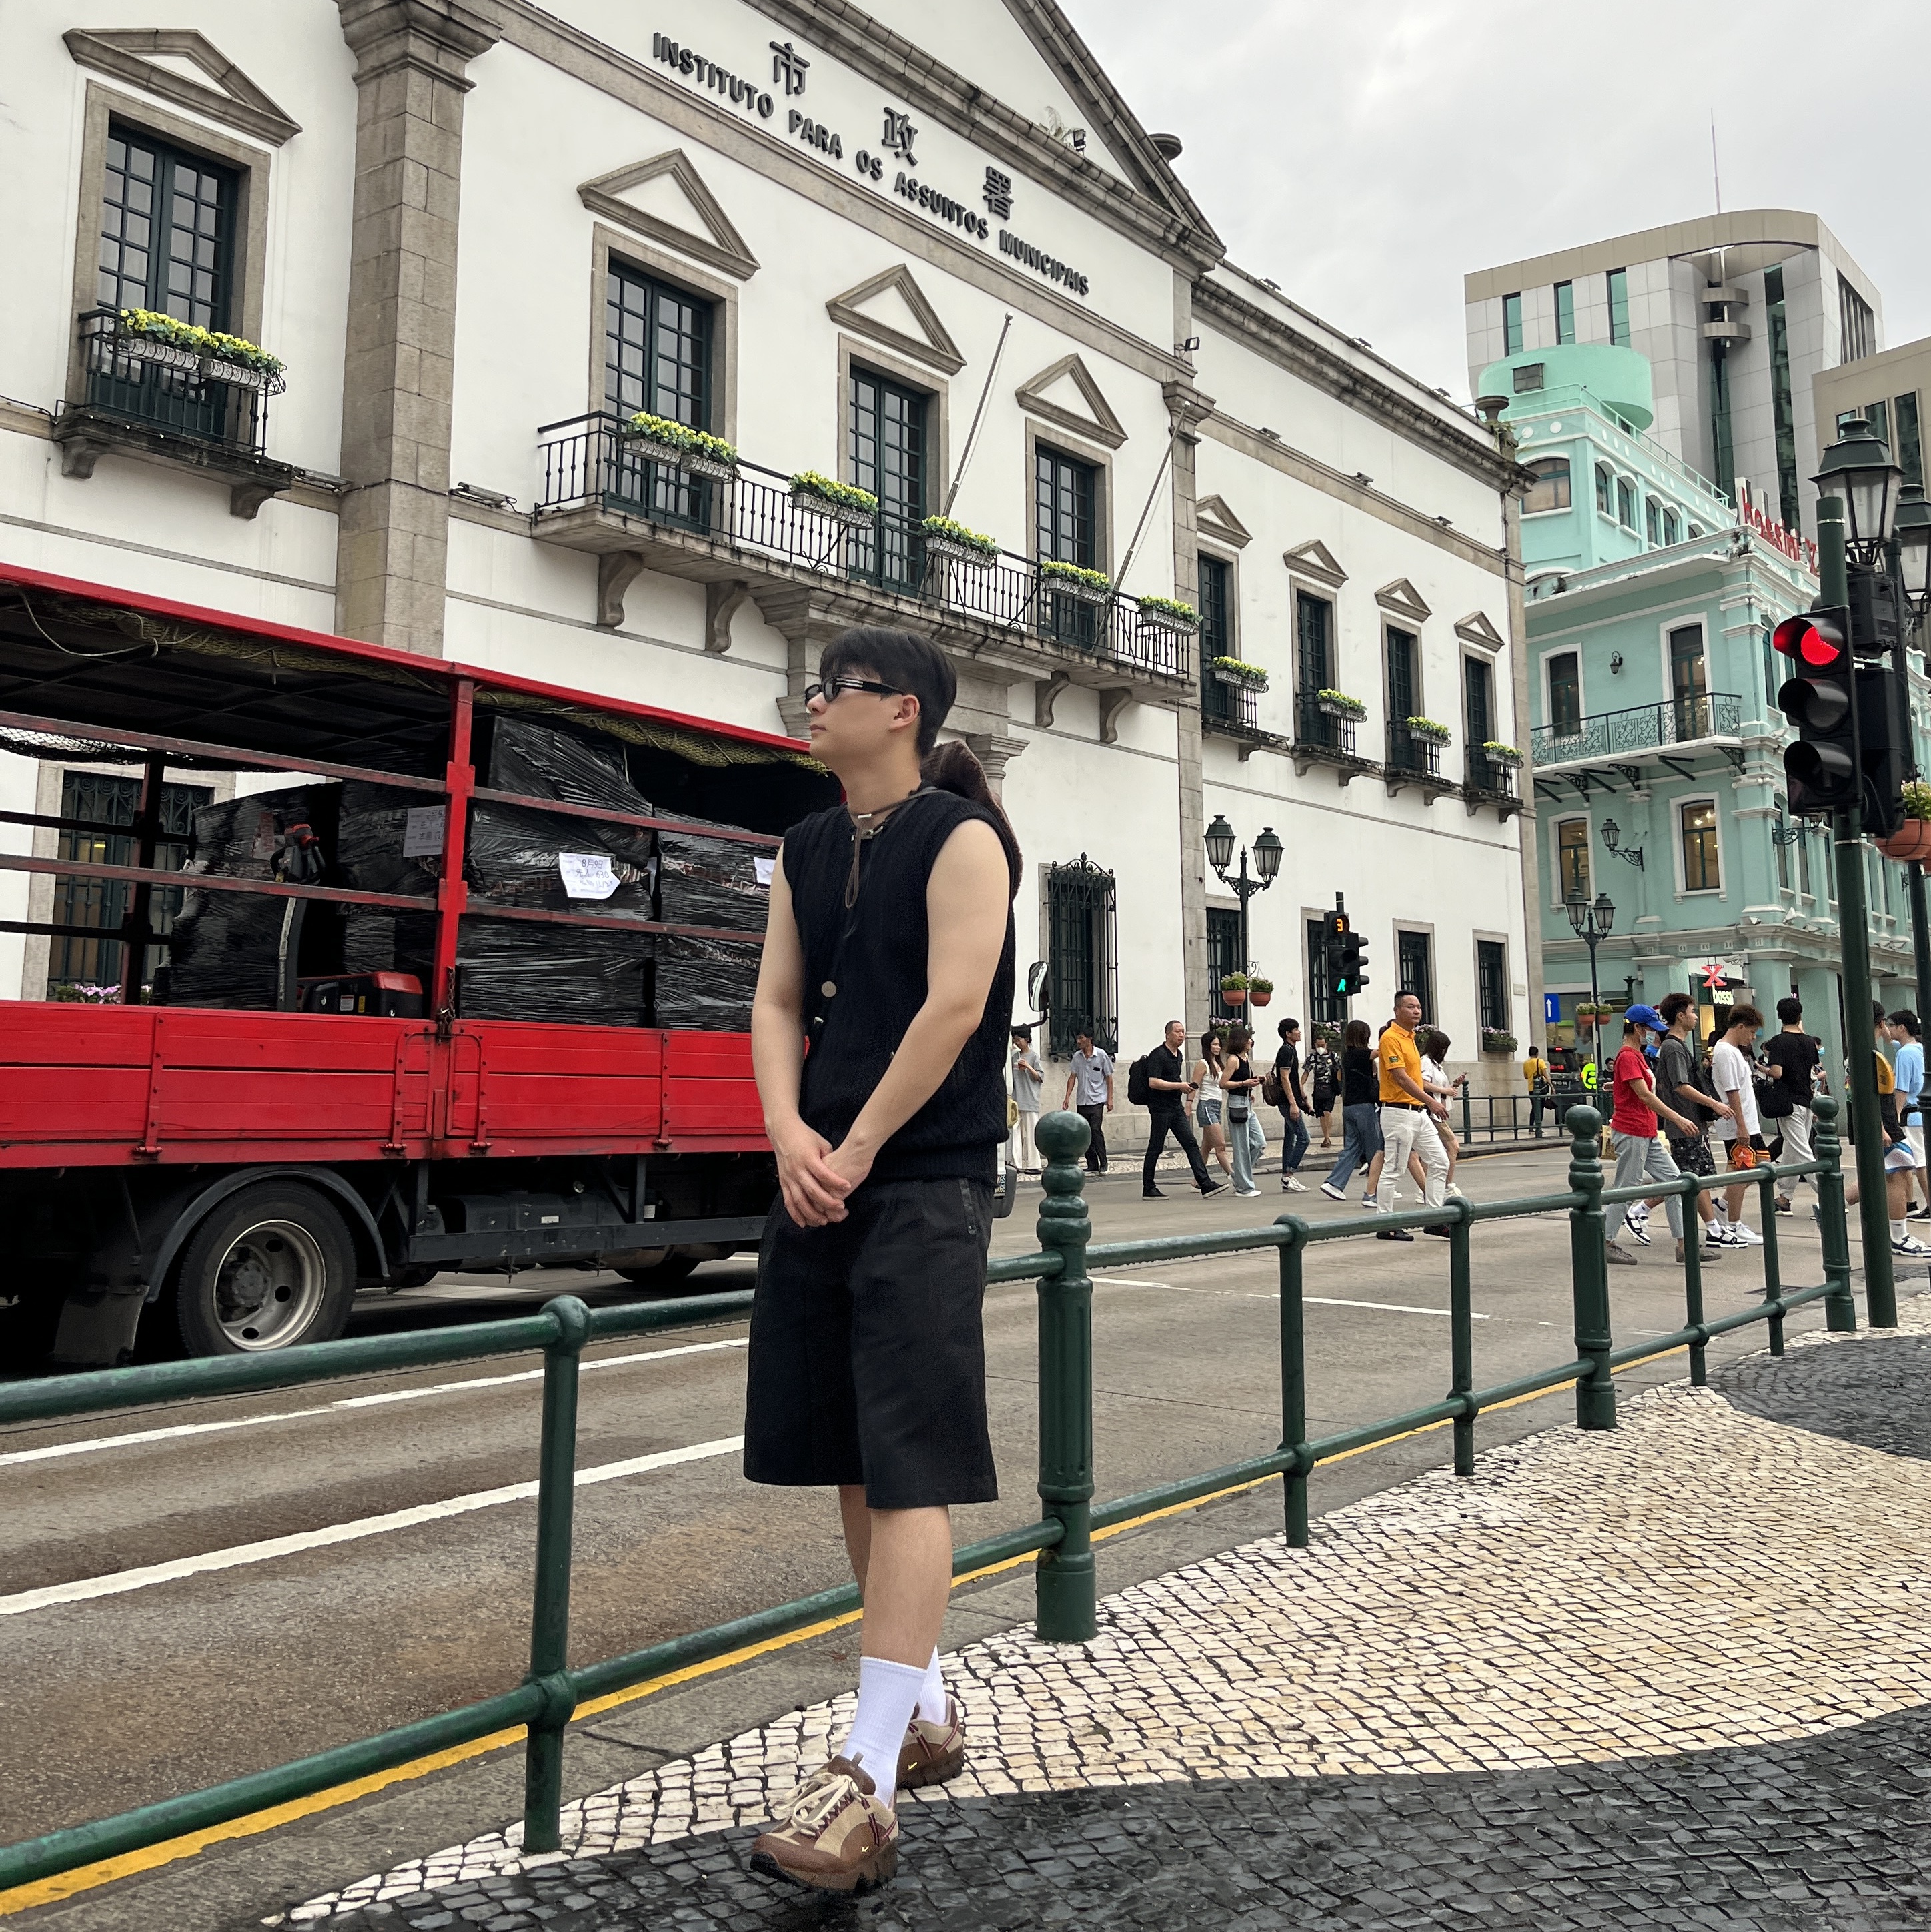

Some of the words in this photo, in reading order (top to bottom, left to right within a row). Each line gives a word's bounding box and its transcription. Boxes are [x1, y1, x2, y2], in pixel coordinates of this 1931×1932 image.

[653, 32, 774, 118] INSTITUTO
[789, 109, 844, 160] PARA
[856, 150, 883, 181] OS
[894, 171, 989, 240] ASSUNTOS
[999, 229, 1089, 296] MUNICIPAIS
[770, 41, 1014, 221] 市政署
[1336, 918, 1343, 932] 3
